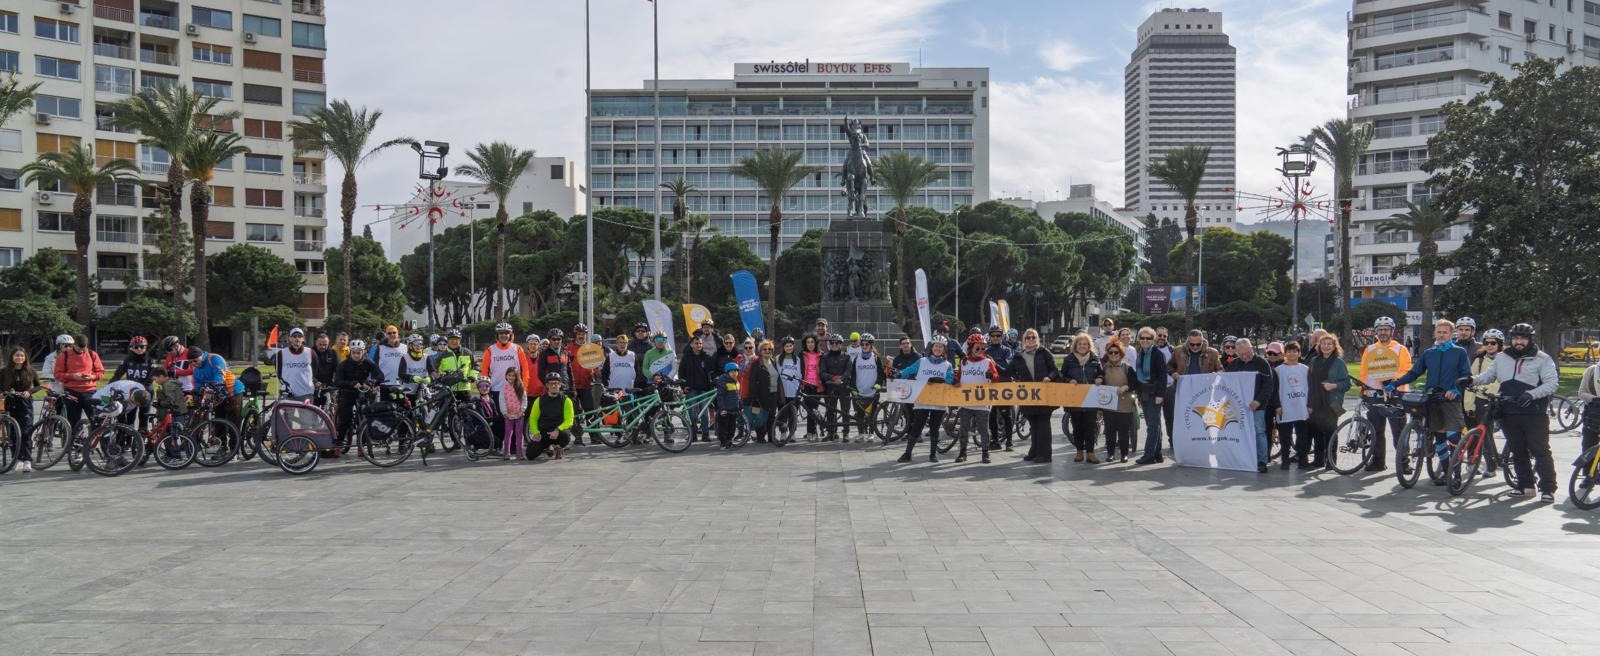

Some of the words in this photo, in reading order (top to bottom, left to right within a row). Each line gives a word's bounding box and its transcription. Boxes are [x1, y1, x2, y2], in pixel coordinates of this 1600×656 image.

[753, 58, 809, 73] swissôtel
[817, 62, 857, 73] BÜYÜK
[863, 63, 892, 73] EFES
[127, 369, 148, 379] PAS
[922, 369, 945, 377] TÜRGÖK
[962, 367, 985, 376] TÜRGÖK
[962, 385, 1042, 401] TÜRGÖK
